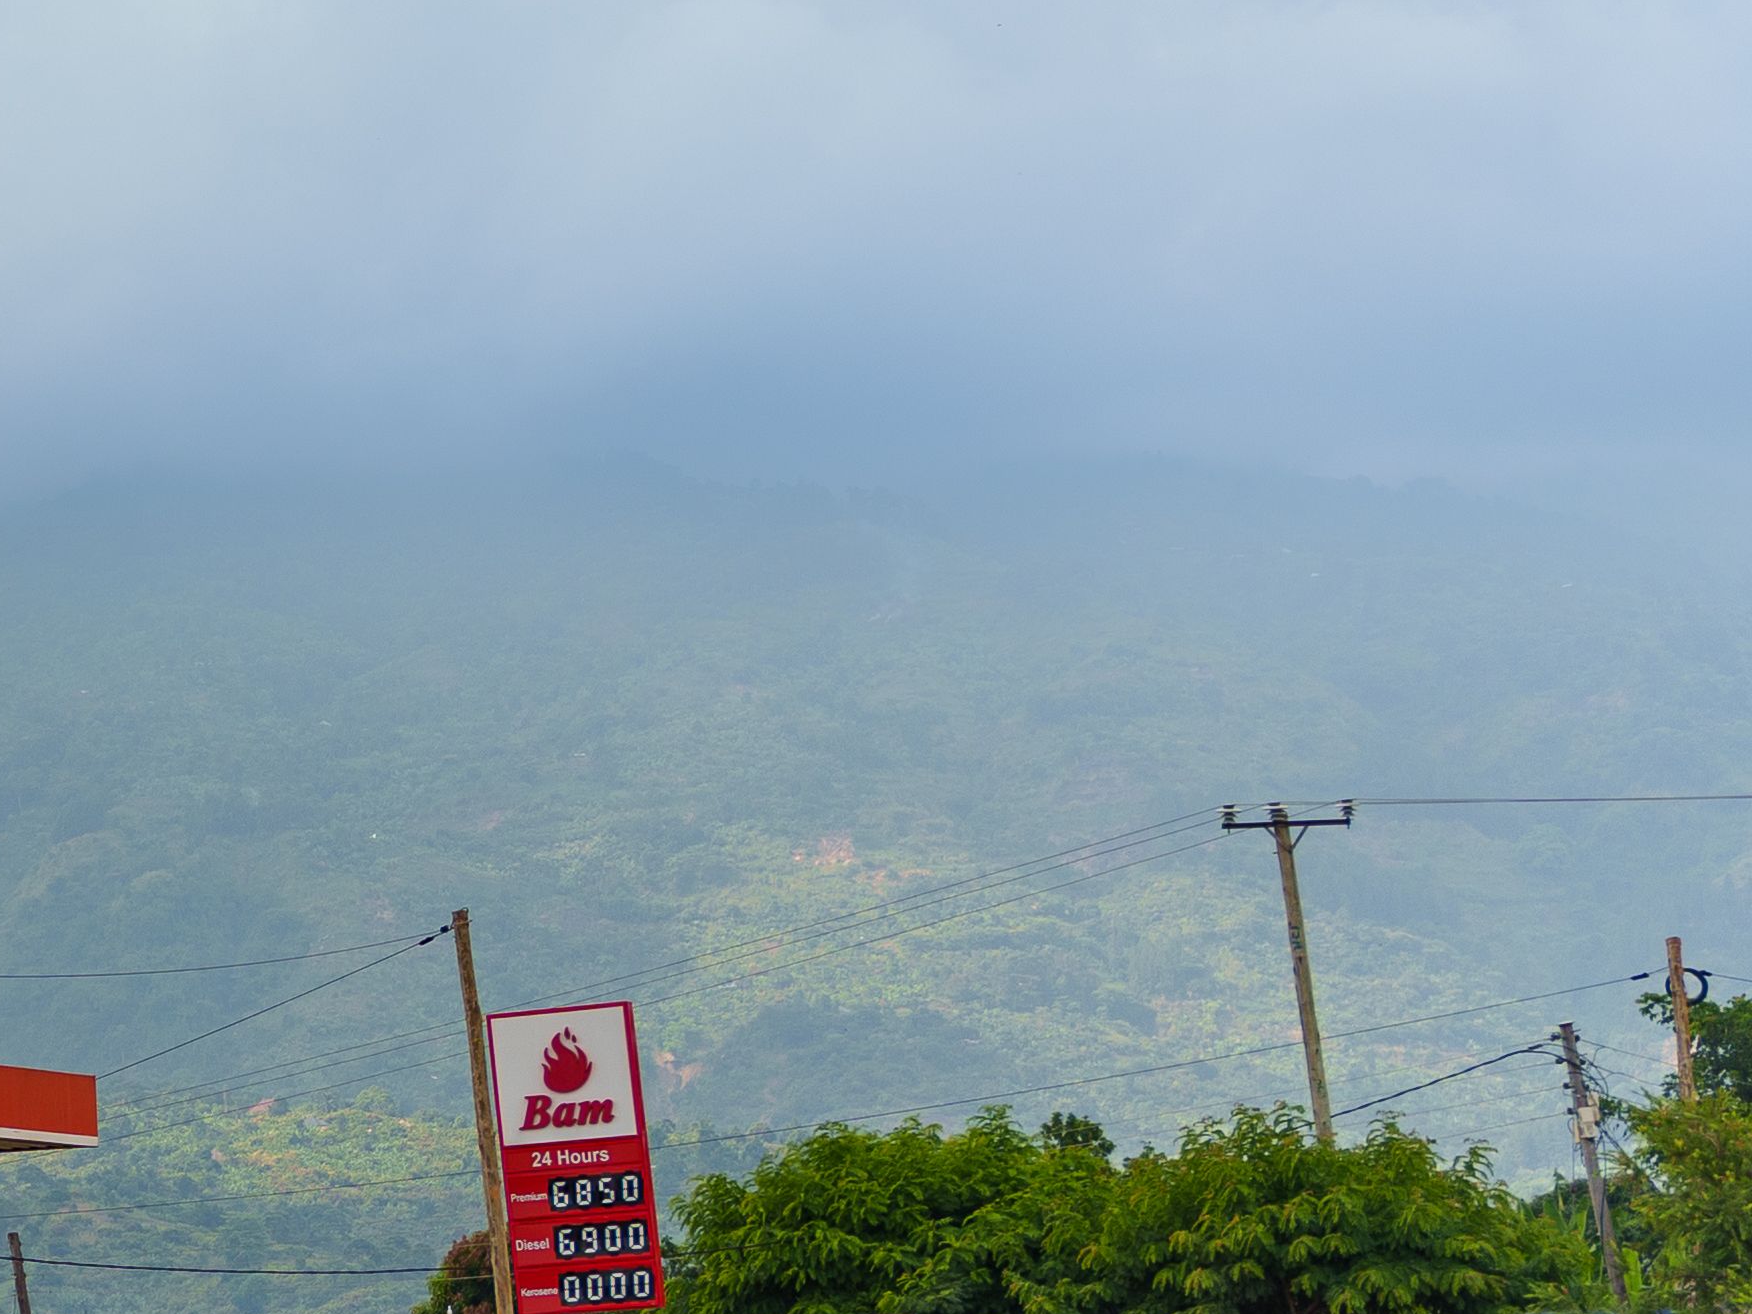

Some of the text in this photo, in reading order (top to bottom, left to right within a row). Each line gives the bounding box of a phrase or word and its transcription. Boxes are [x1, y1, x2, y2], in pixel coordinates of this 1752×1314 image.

[519, 1094, 615, 1131] Bam
[532, 1149, 610, 1167] 24 Hours
[510, 1174, 639, 1208] Premium 6850
[515, 1223, 645, 1256] Diesel 6900
[520, 1270, 650, 1303] Kerosene 0000
